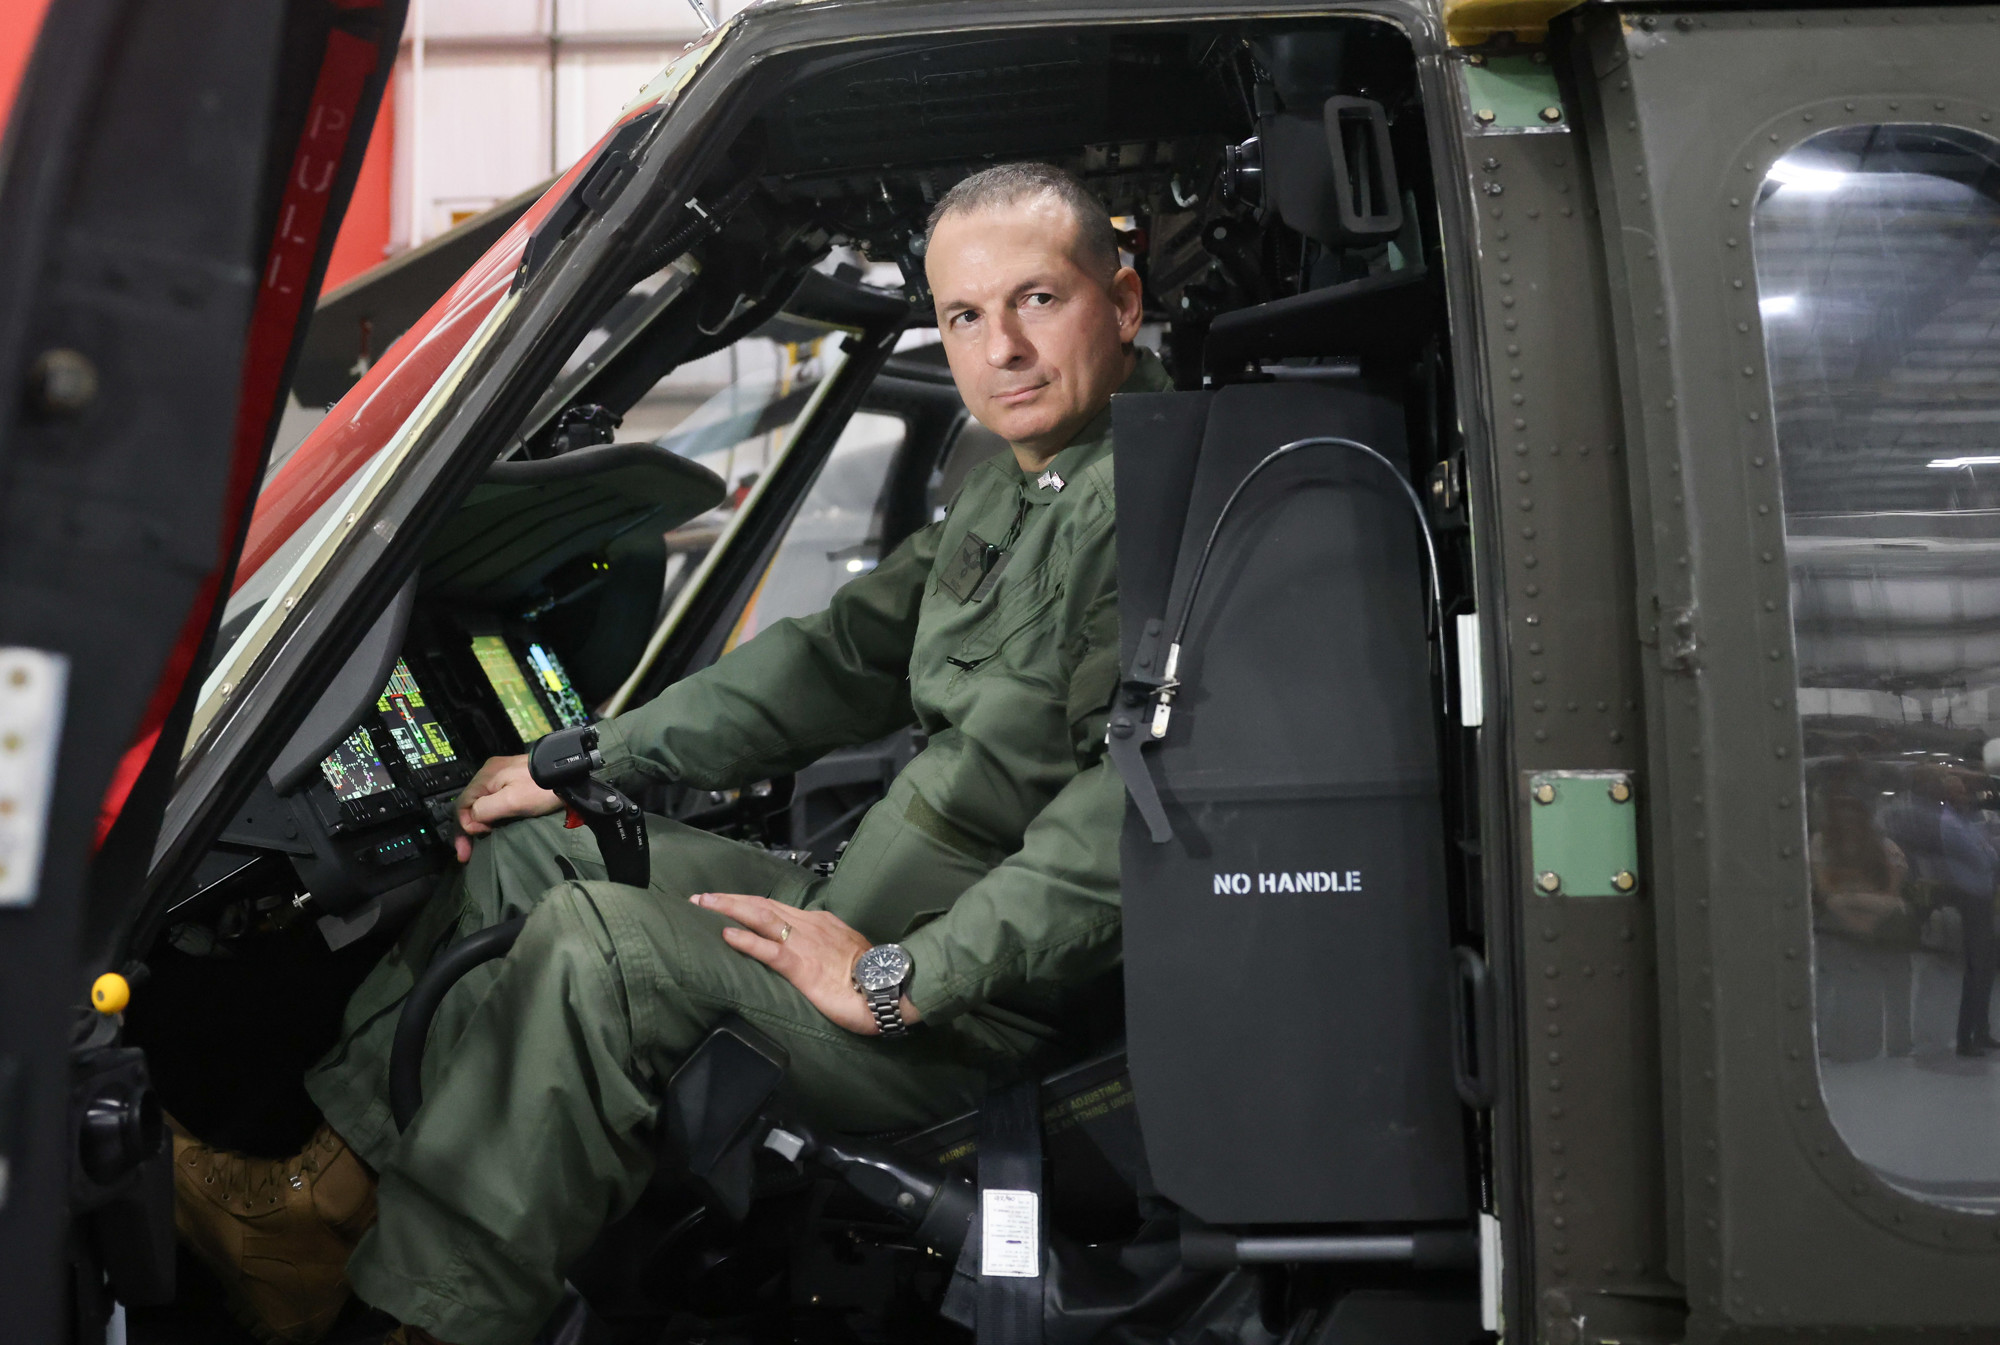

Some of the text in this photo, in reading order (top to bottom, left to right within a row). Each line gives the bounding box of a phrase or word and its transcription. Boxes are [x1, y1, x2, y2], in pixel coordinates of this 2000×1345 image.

[267, 104, 347, 294] PULL
[566, 754, 580, 763] TRIM
[1213, 870, 1363, 895] NO HANDLE
